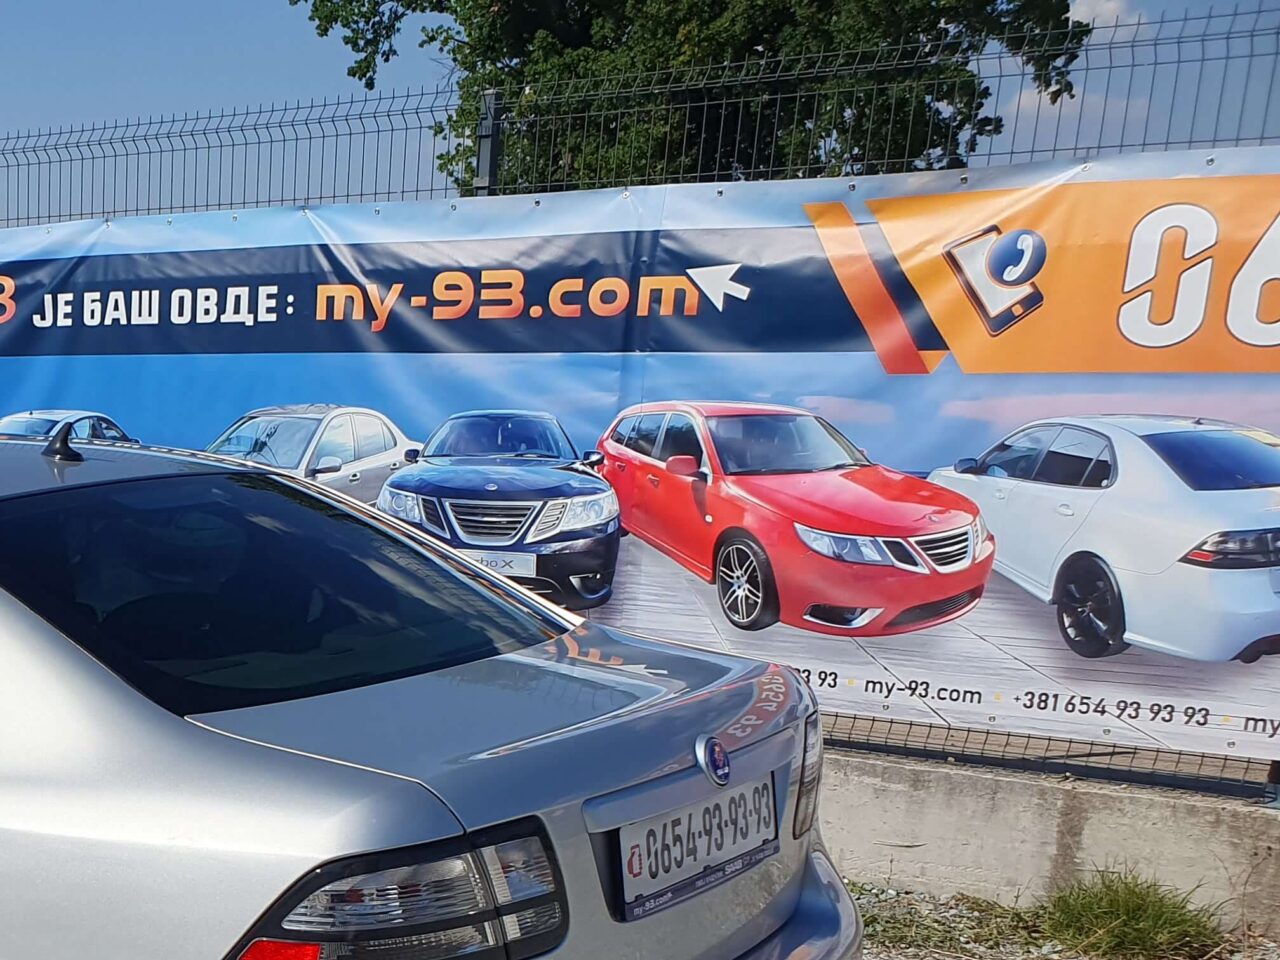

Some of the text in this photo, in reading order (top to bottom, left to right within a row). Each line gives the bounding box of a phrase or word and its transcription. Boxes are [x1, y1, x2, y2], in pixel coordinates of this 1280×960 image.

[32, 292, 74, 328] ЈЕ
[83, 289, 160, 327] БАШ
[315, 268, 700, 332] my-93.com
[501, 559, 515, 569] X
[817, 671, 838, 688] 93
[864, 679, 983, 704] my-93.com
[1013, 691, 1060, 712] +381
[1064, 695, 1108, 717] 654
[1115, 700, 1141, 719] 93
[1149, 703, 1175, 722] 93
[1183, 706, 1210, 726] 93
